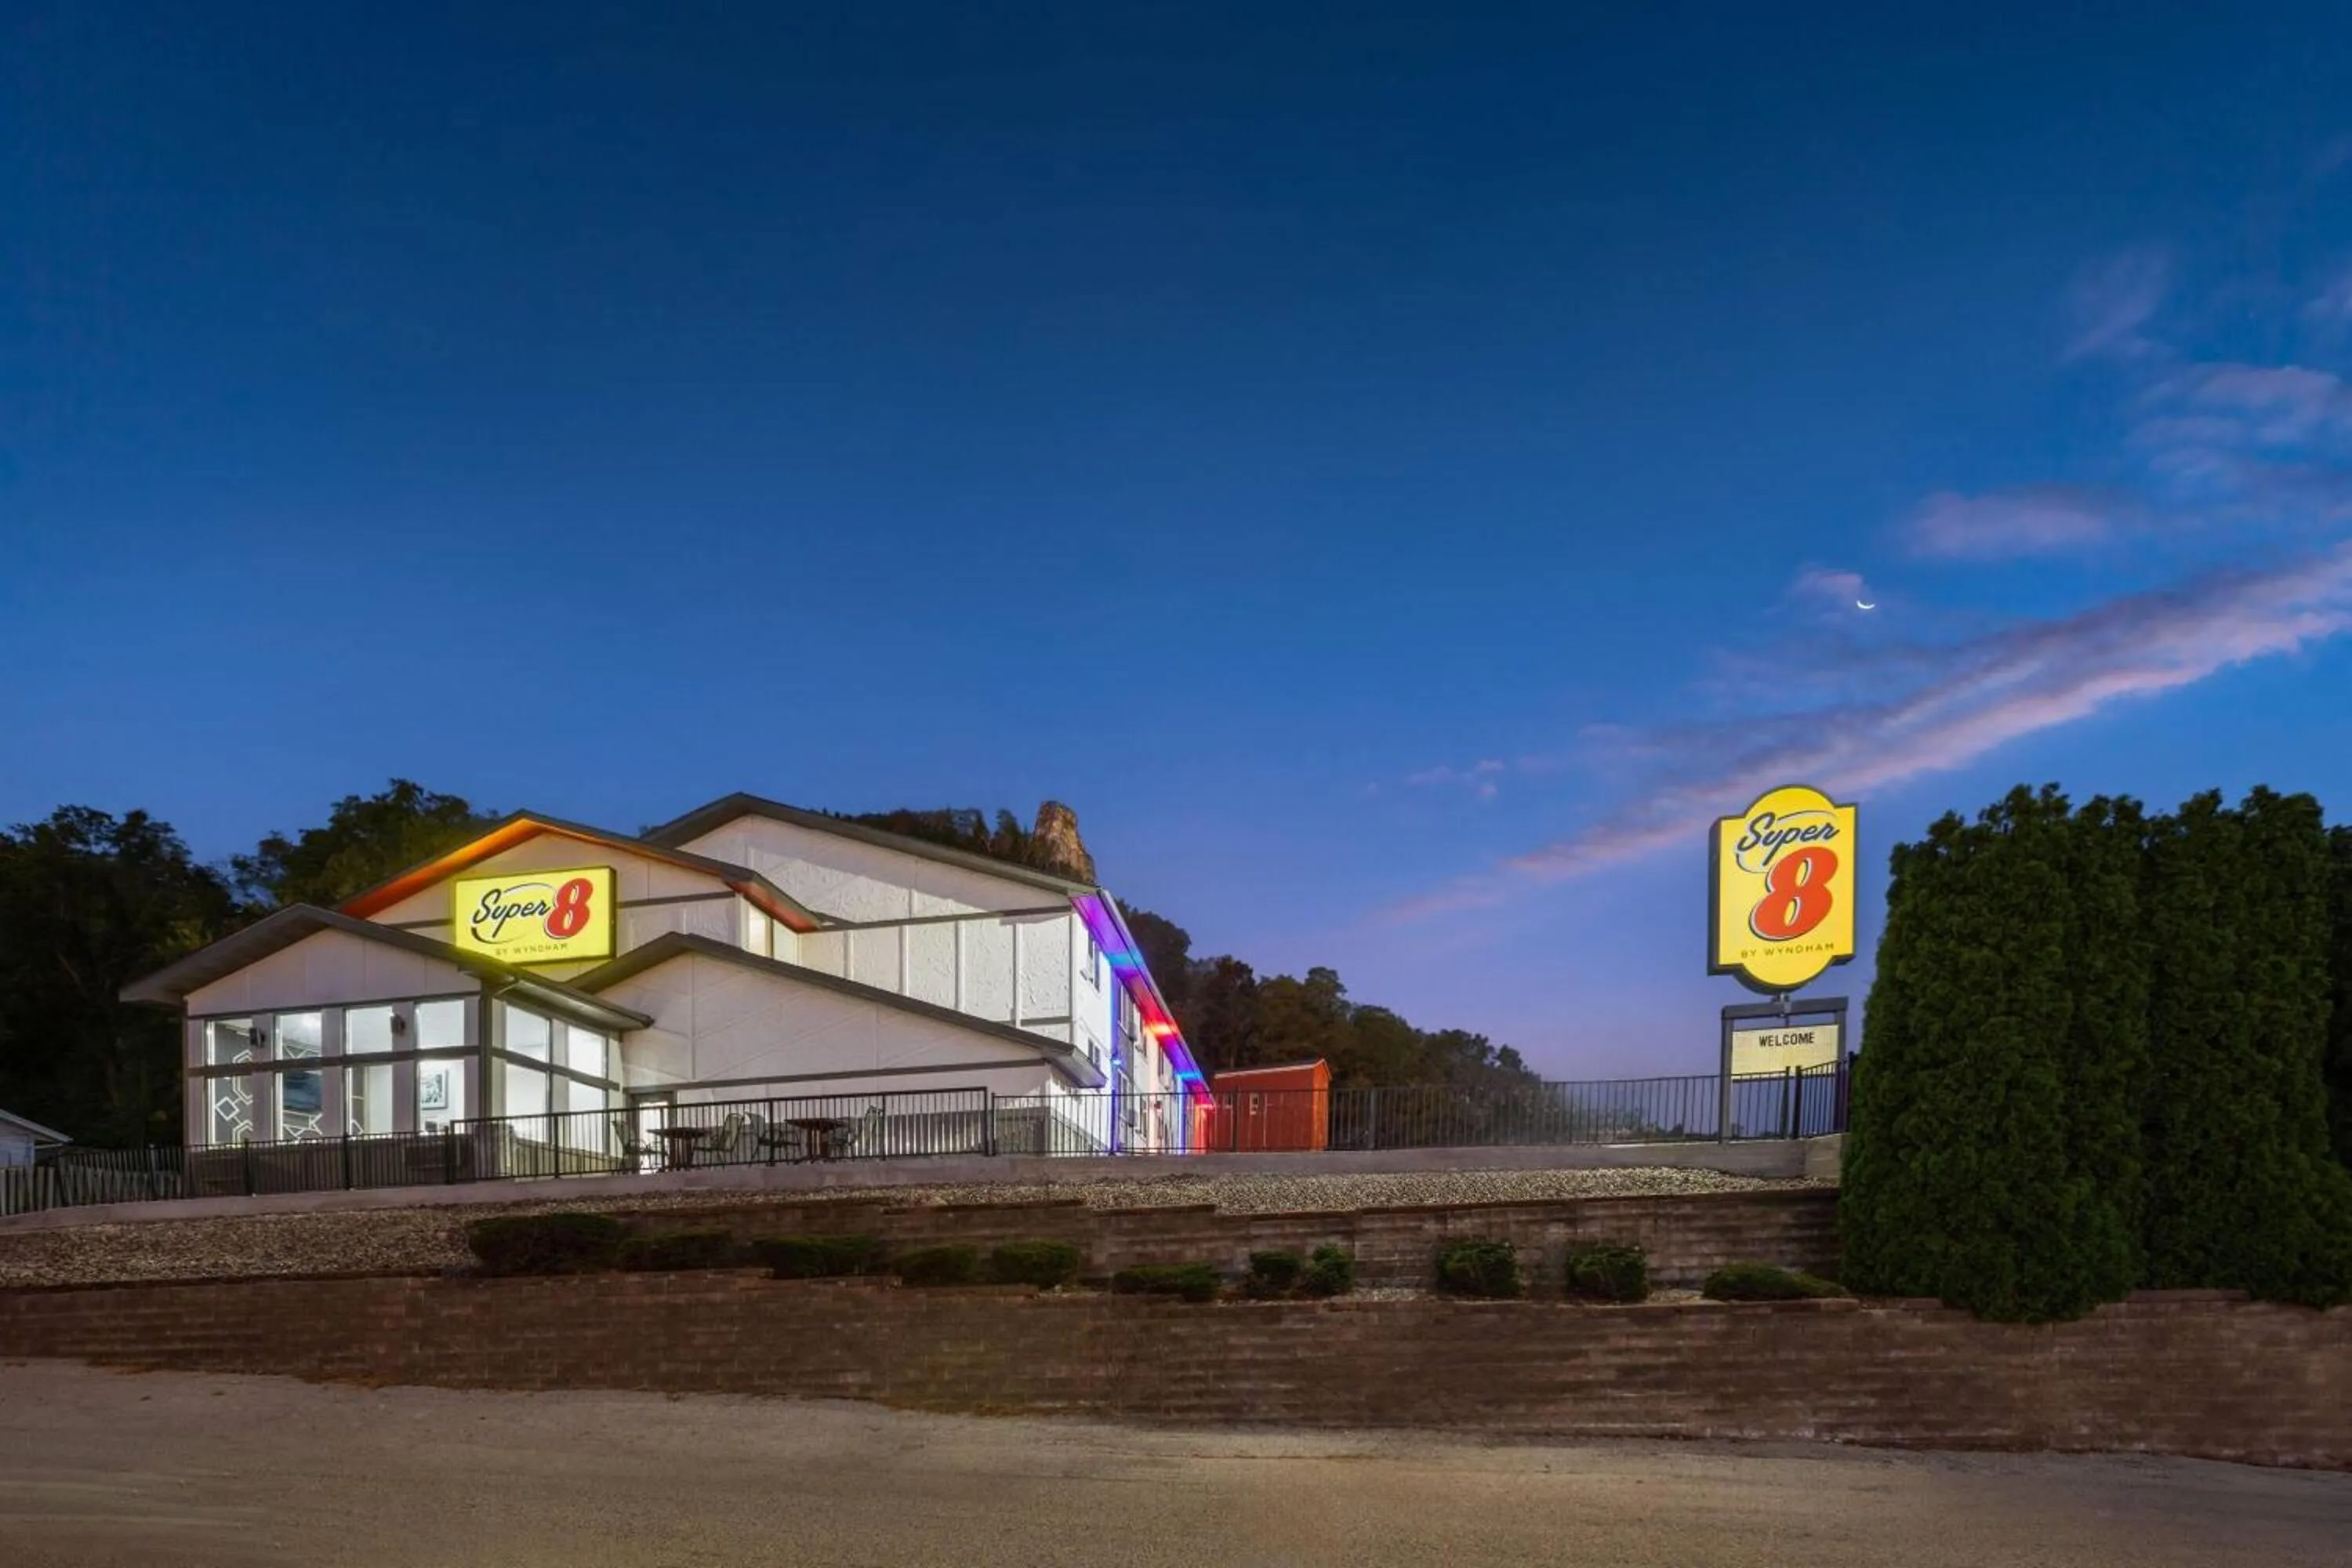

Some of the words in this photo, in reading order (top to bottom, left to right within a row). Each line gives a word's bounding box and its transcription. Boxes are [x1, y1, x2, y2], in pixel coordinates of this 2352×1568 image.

[1737, 811, 1840, 866] Super
[472, 888, 550, 938] Super
[544, 877, 593, 940] 8
[1748, 846, 1838, 942] 8
[514, 942, 568, 954] WYNDHAM
[1740, 949, 1757, 959] BY
[1765, 942, 1835, 956] WYNDHAM
[1759, 1032, 1815, 1047] WELCOME
